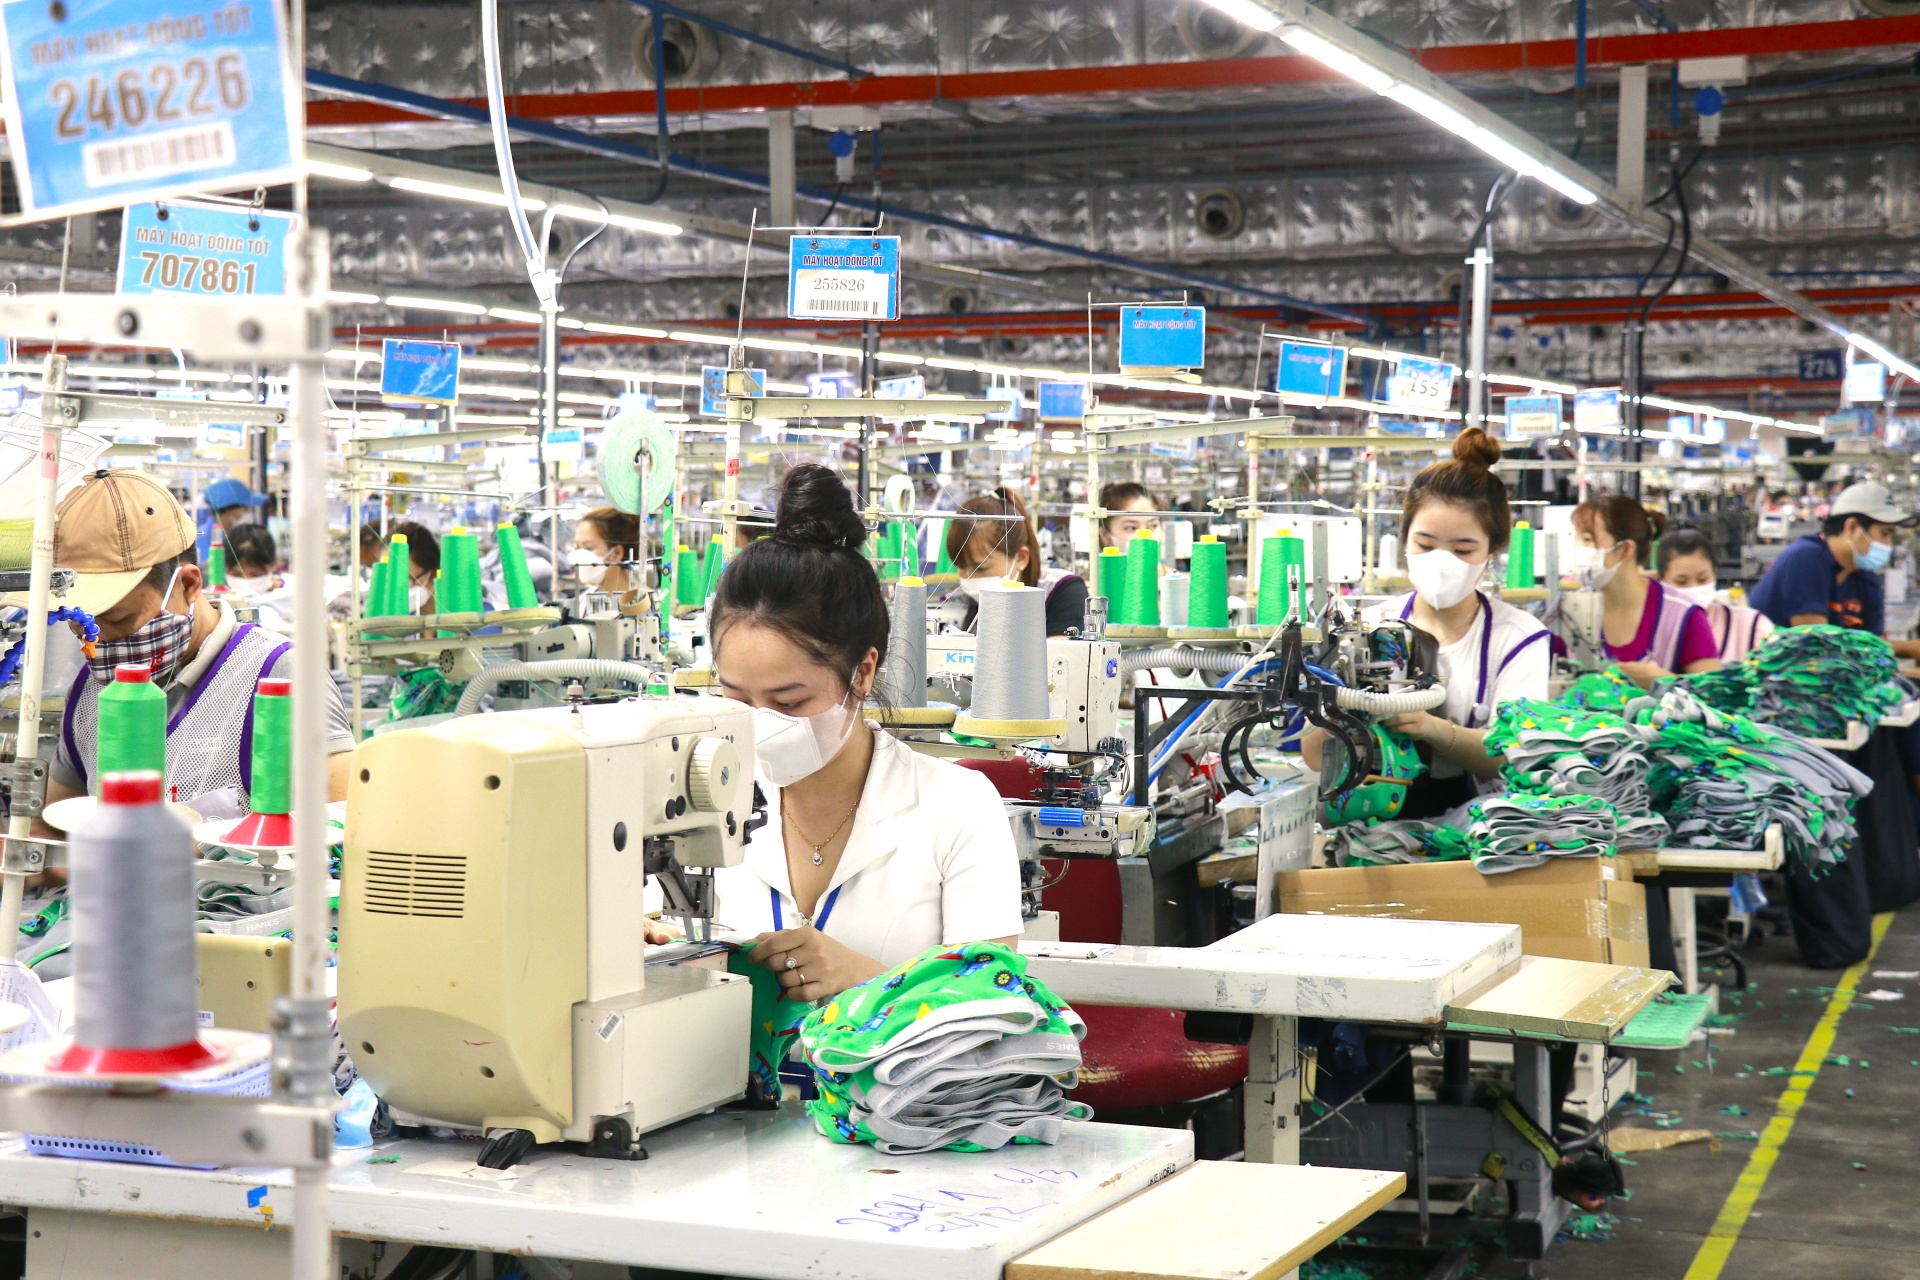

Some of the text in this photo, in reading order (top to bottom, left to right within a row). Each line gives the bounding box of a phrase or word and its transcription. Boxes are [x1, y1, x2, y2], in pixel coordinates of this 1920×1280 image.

[51, 51, 249, 139] 246226
[136, 227, 271, 255] MÁY HOẠT ĐỘNG TỐT
[803, 252, 884, 268] MÁY HOẠT ĐỘNG TỐT
[141, 251, 257, 295] 707861
[813, 278, 865, 292] 255826
[246, 917, 280, 932] HANES
[1046, 1042, 1080, 1052] ANES
